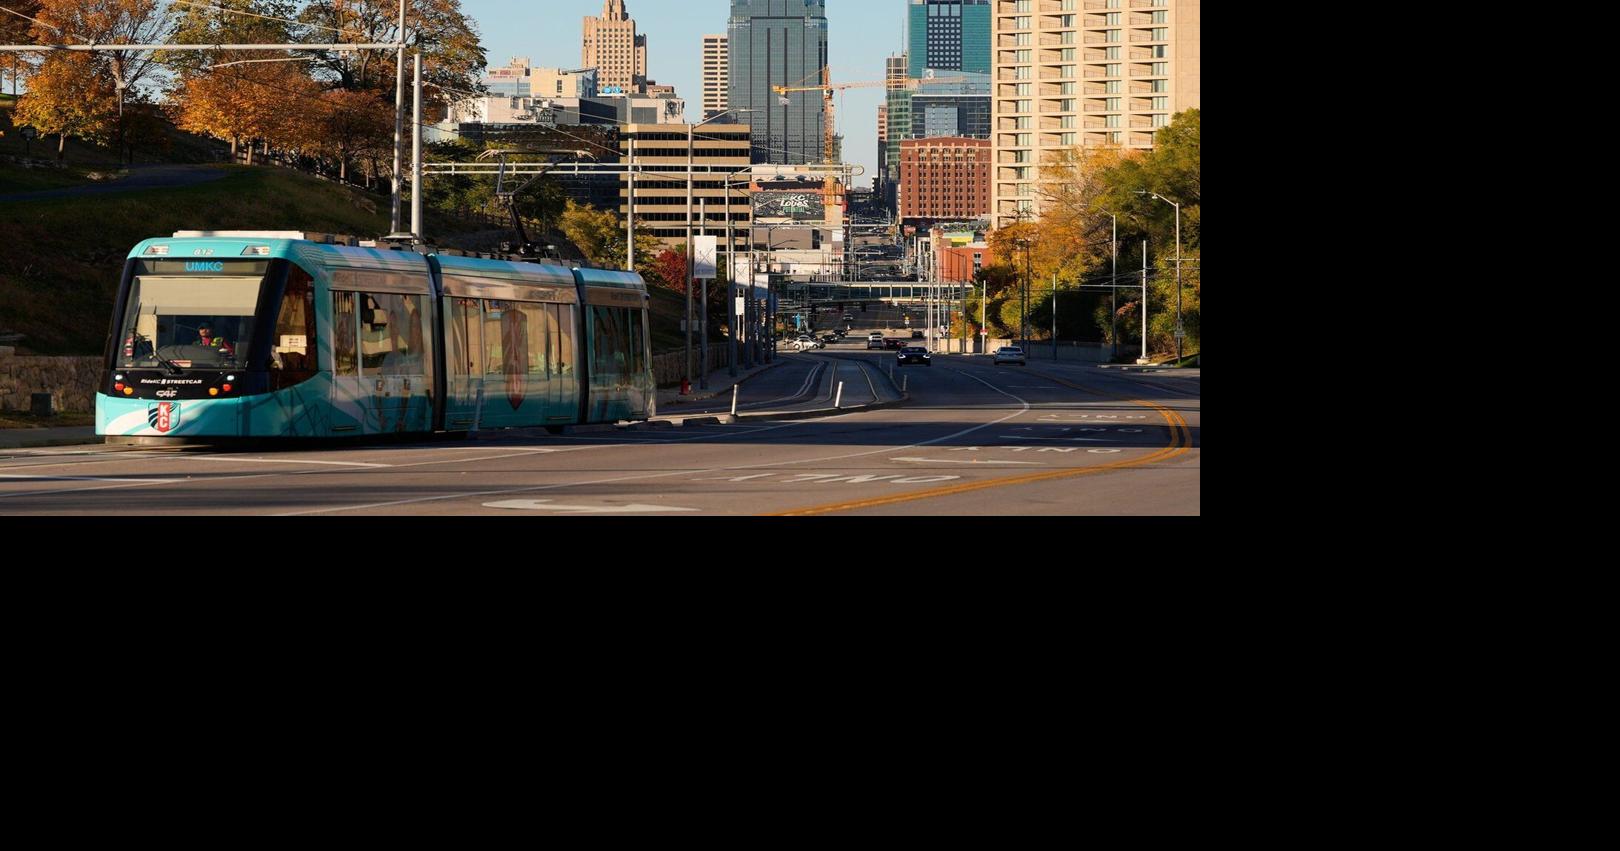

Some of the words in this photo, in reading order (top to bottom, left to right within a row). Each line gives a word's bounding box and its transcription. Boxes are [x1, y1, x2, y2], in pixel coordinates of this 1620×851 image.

[186, 261, 223, 271] UMKC
[160, 404, 169, 428] KC
[947, 446, 1121, 454] ONLY
[692, 473, 962, 484] ONLY
